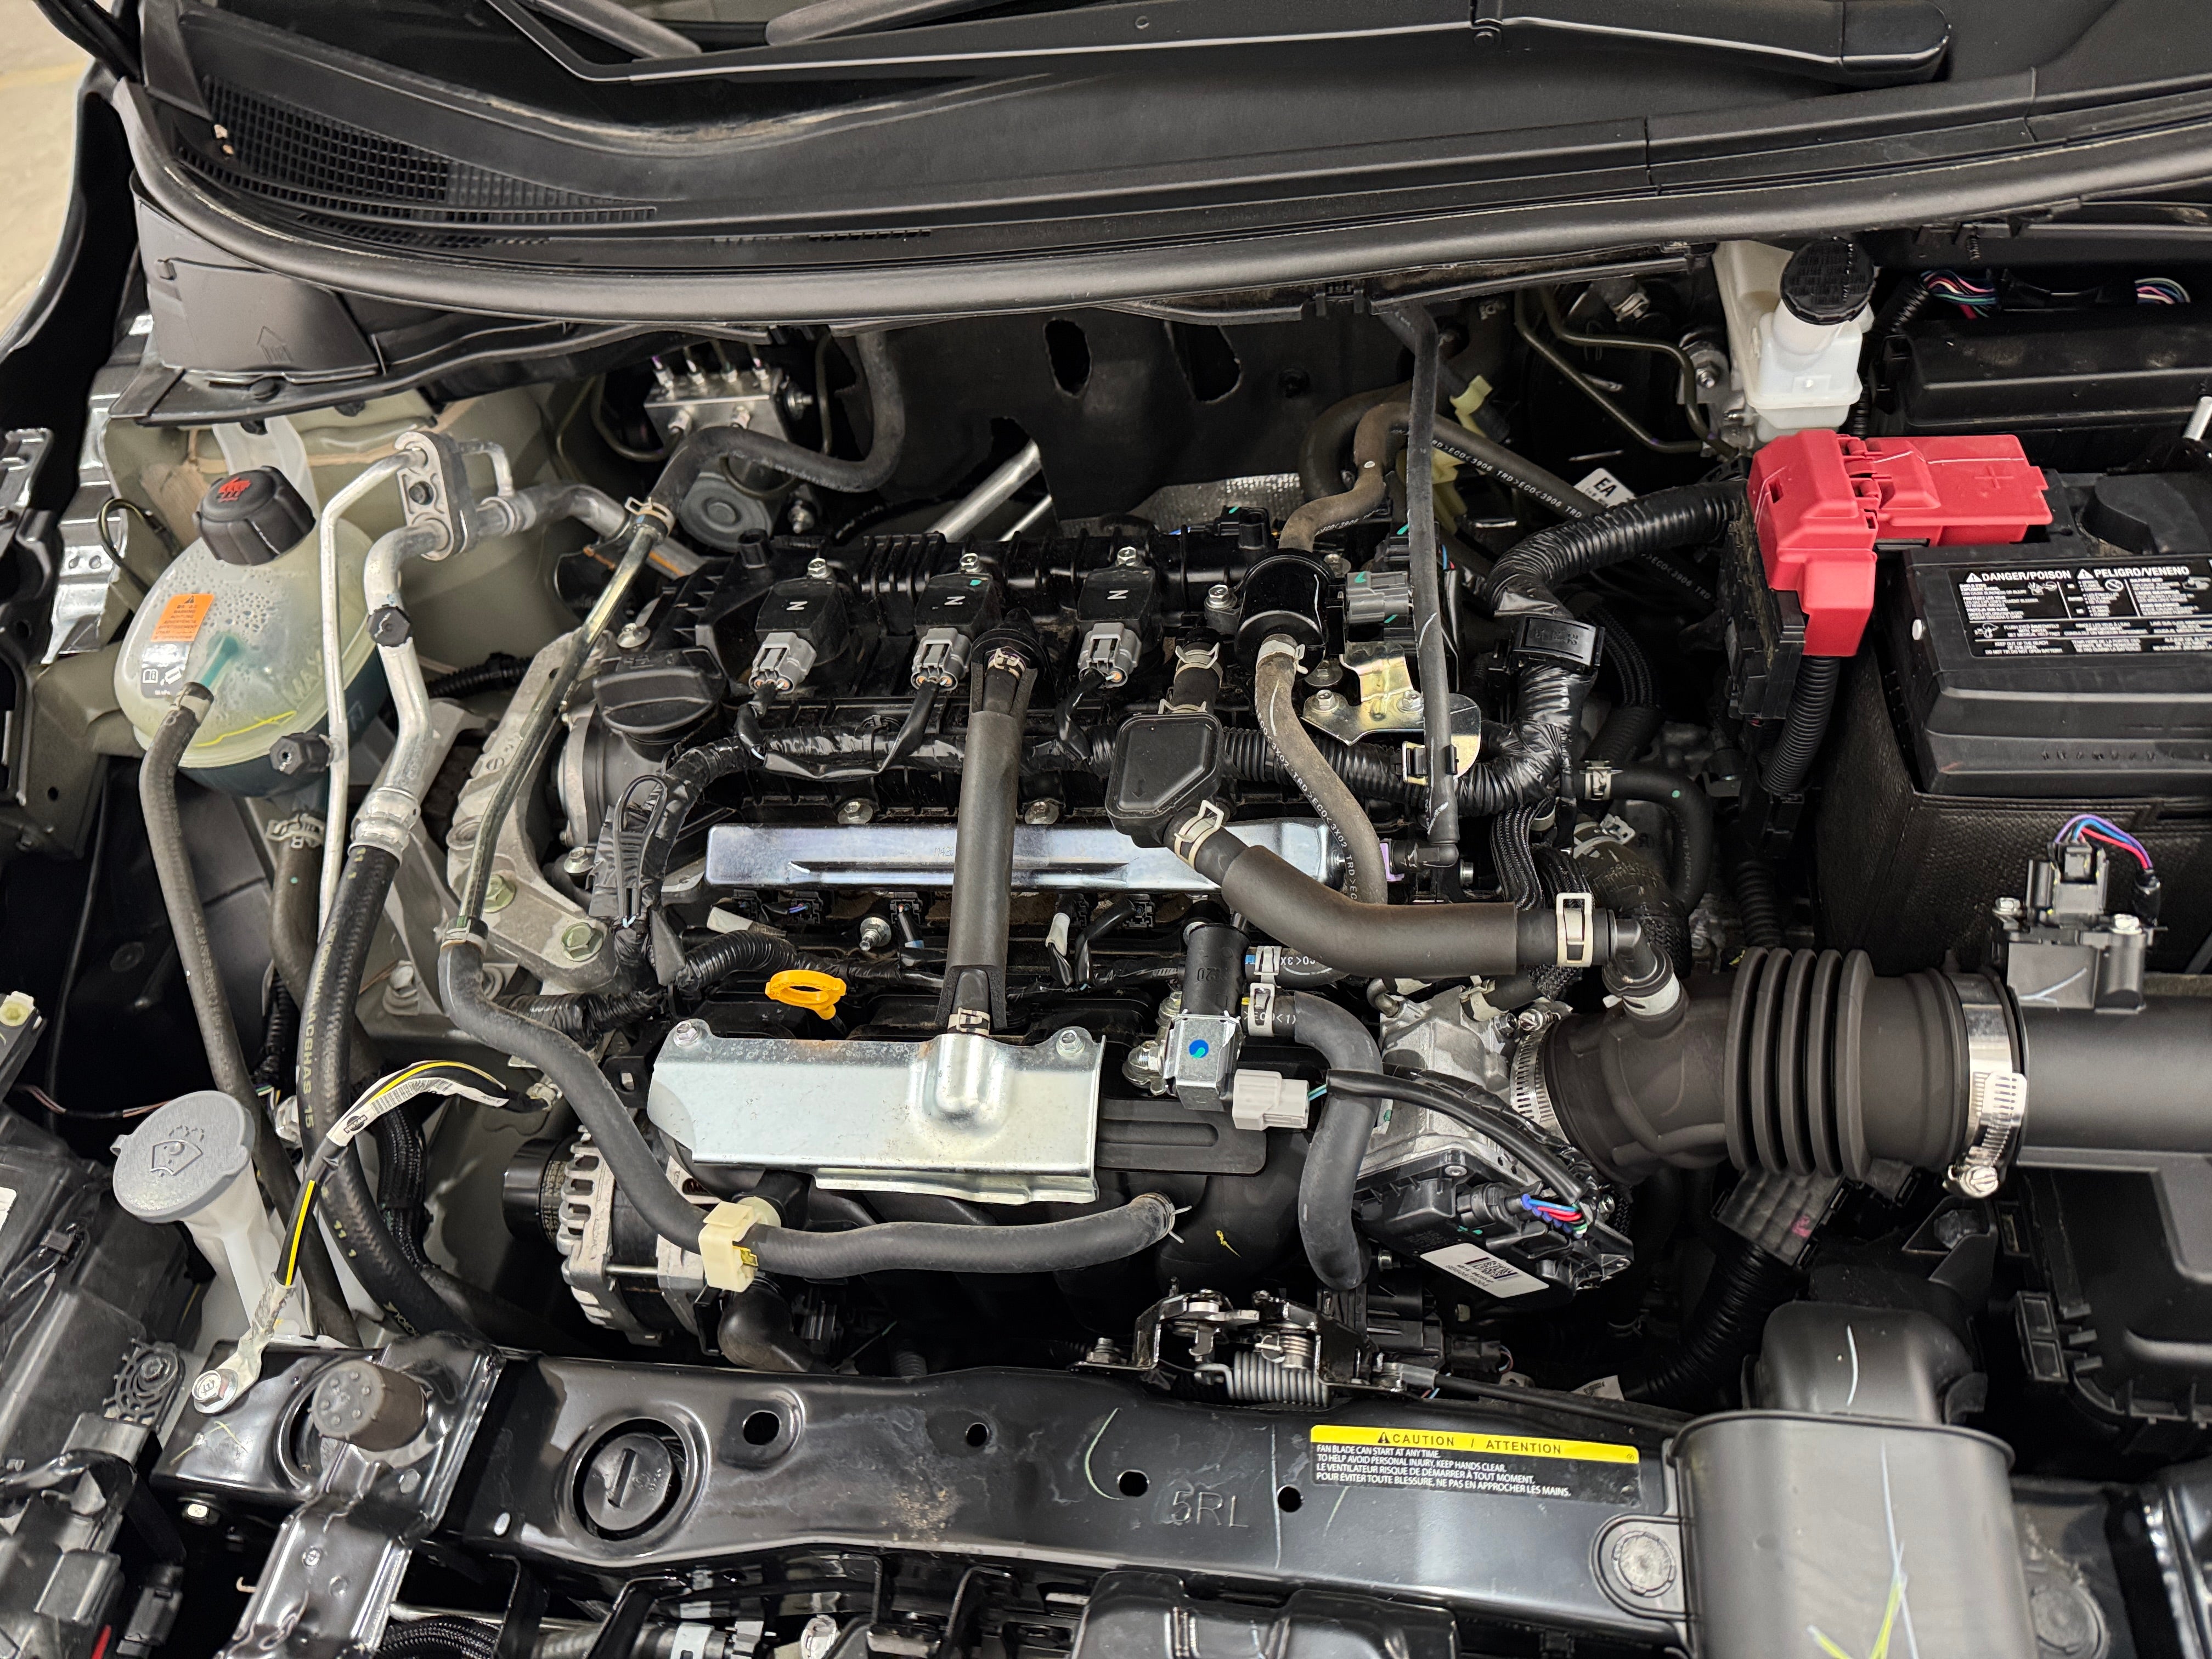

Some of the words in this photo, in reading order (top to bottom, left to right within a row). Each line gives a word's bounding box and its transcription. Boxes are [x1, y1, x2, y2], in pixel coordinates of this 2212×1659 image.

[1593, 477, 1618, 498] EA
[1564, 505, 1583, 519] TRD
[1981, 569, 2072, 582] DANGER/POISON
[2093, 566, 2190, 578] PELIGRO/VENENO
[1293, 772, 1348, 849] TRD>ECO<3X02
[304, 1104, 314, 1129] 15
[344, 1114, 368, 1134] NISSAN
[1317, 1444, 1331, 1453] FAN
[1332, 1445, 1356, 1454] BLADE
[1357, 1446, 1372, 1455] CAN
[1373, 1447, 1394, 1456] START
[1406, 1449, 1421, 1457] ANY
[1392, 1434, 1454, 1446] CAUTION
[1470, 1438, 1475, 1448] /
[1486, 1440, 1561, 1454] ATTENTION
[1317, 1454, 1328, 1462] TO
[1329, 1454, 1347, 1463] HELP
[1347, 1455, 1370, 1464] AVOID
[1372, 1457, 1408, 1466] PERSONAL
[1409, 1458, 1436, 1468] INJURY,
[1437, 1460, 1454, 1469] KEEP
[1455, 1461, 1481, 1471] HANDS
[1482, 1463, 1507, 1473] CLEAR.
[1317, 1463, 1326, 1471] LE
[1327, 1464, 1378, 1474] VENTILATEUR
[1380, 1466, 1408, 1476] RISQUE
[1409, 1468, 1420, 1476] DE
[1422, 1466, 1465, 1479] DÉMARRER
[1474, 1471, 1495, 1481] TOUT
[1497, 1474, 1536, 1485] MOMENT.
[1317, 1472, 1339, 1481] POUR
[1340, 1471, 1366, 1482] ÉVITER
[1368, 1476, 1393, 1485] TOUTE
[1394, 1476, 1435, 1487] BLESSURE,
[1436, 1479, 1447, 1487] NE
[1448, 1480, 1464, 1489] PAS
[1465, 1481, 1476, 1489] EN
[1477, 1482, 1525, 1494] APPROCHER
[1542, 1486, 1572, 1497] MAINS.
[1171, 1491, 1250, 1528] 5RL
